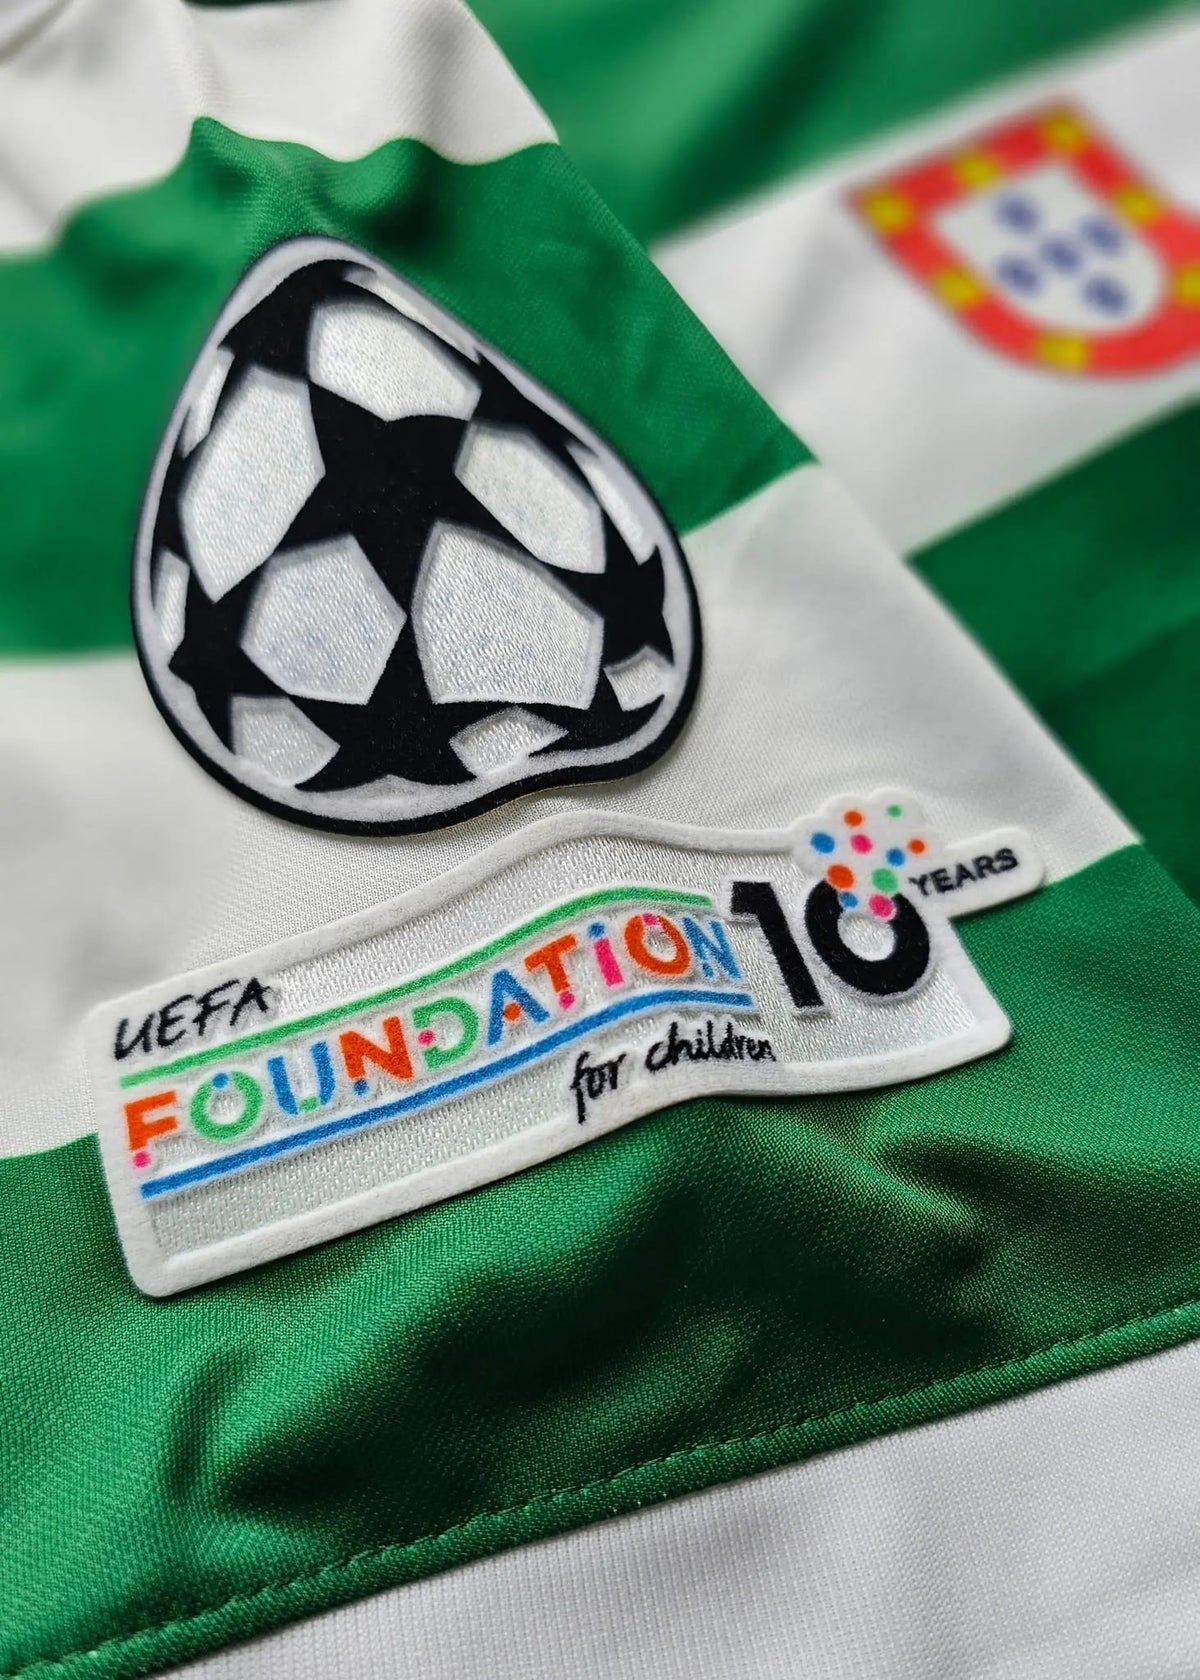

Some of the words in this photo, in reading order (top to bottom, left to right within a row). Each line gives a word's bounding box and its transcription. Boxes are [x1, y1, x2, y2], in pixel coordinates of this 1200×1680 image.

[730, 880, 930, 1009] 10
[909, 847, 1018, 898] YEARS
[114, 976, 271, 1061] UEFA
[123, 912, 742, 1169] FOUNDATION
[570, 1051, 627, 1124] for
[645, 1016, 777, 1073] children
